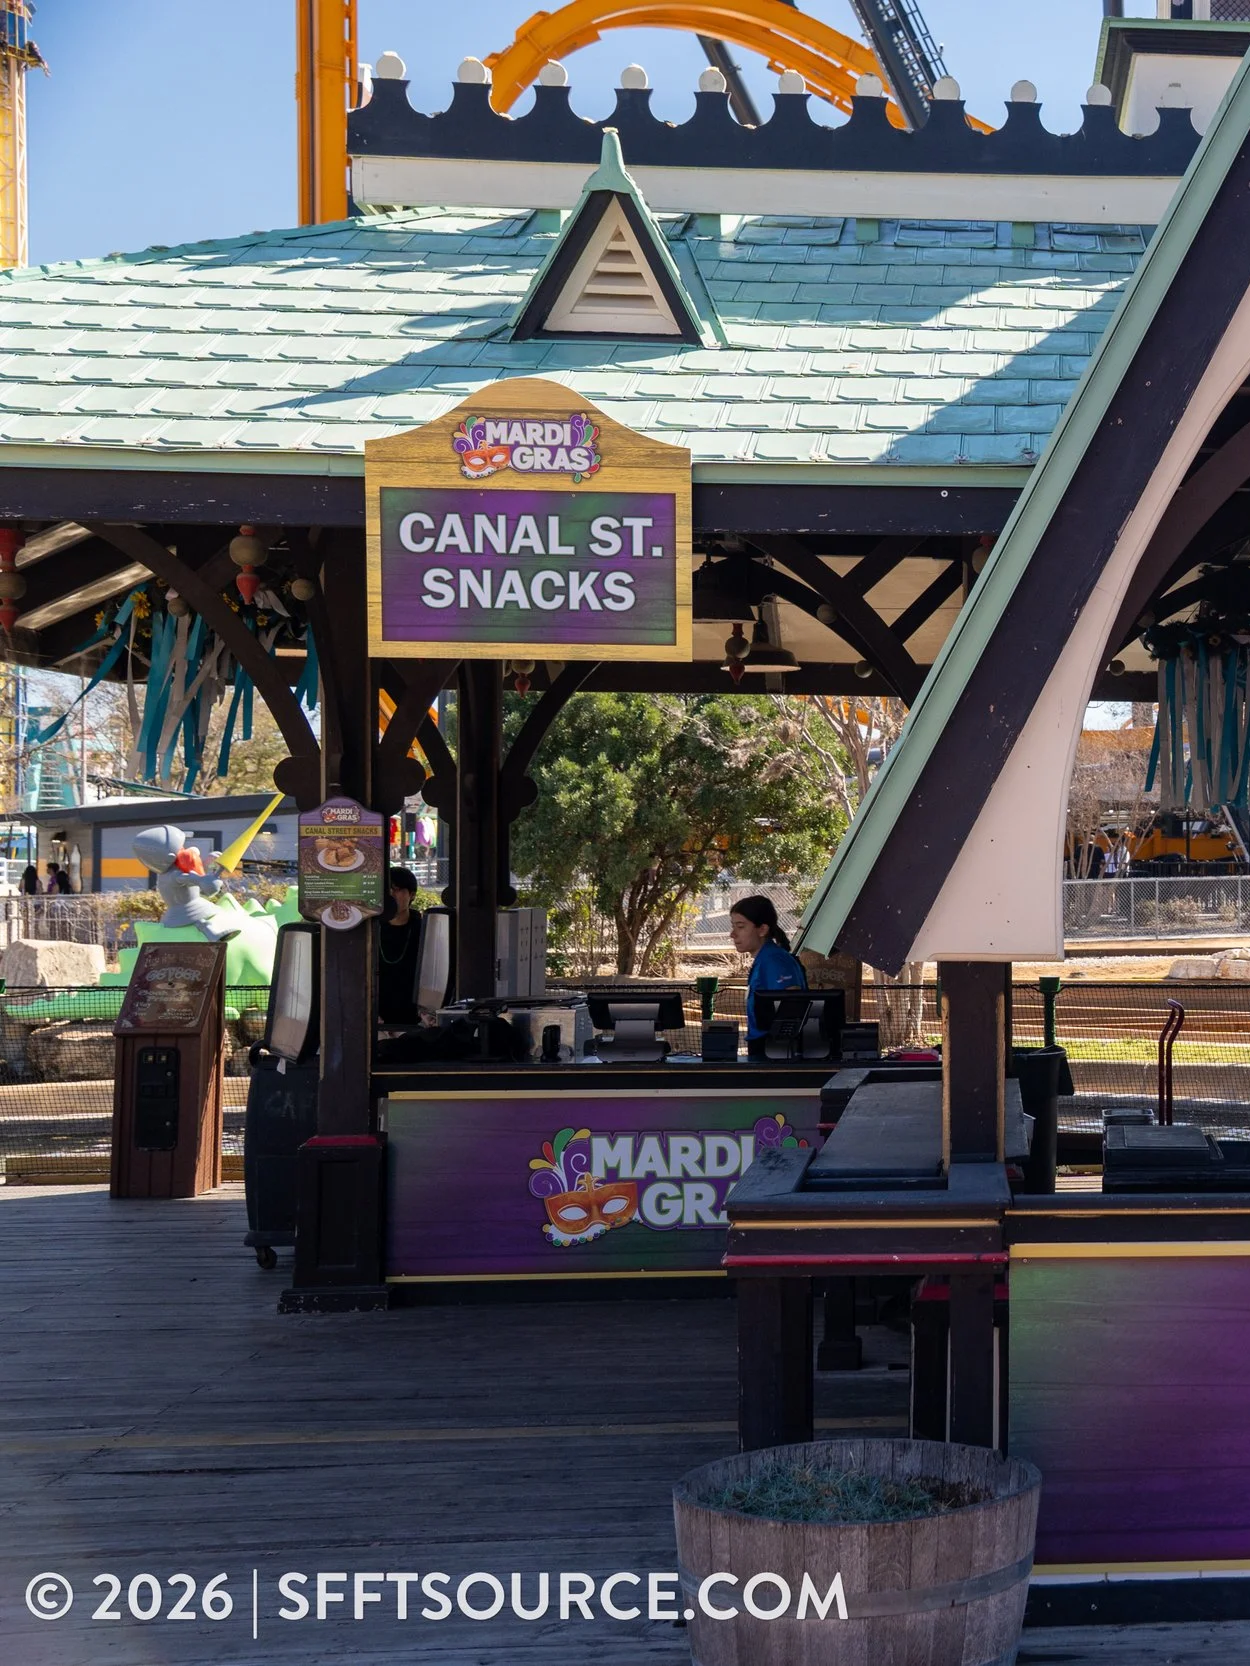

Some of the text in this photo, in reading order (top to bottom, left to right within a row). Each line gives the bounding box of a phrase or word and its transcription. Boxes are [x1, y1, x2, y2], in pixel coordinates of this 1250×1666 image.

[485, 420, 572, 447] MARDI
[511, 446, 592, 473] GRAS
[399, 512, 663, 558] CANAL ST.
[420, 567, 636, 612] SNACKS
[330, 807, 353, 815] MARDI
[337, 814, 358, 822] GRAS
[304, 827, 378, 835] CANAL STREET SNACKS
[591, 1135, 756, 1179] MARDI
[641, 1182, 732, 1226] GR
